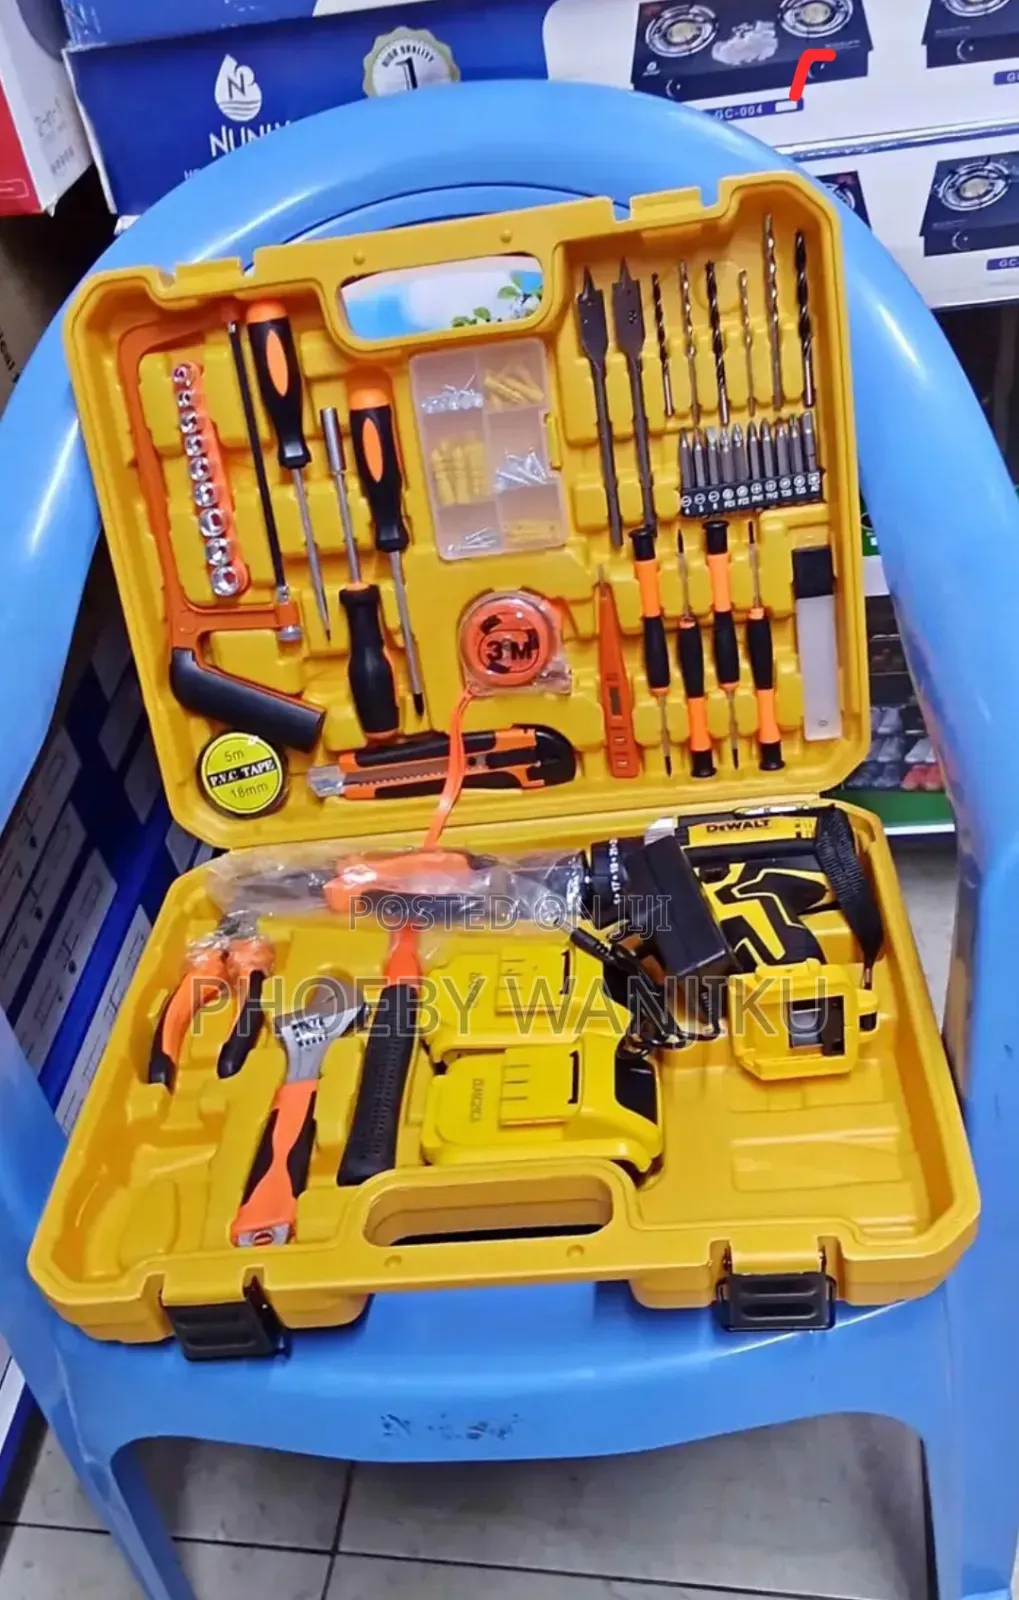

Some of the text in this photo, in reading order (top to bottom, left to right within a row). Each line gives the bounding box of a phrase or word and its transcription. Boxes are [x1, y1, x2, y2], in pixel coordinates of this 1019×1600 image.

[224, 749, 245, 762] 5m
[240, 758, 275, 777] TAPE
[230, 781, 269, 798] 18mm
